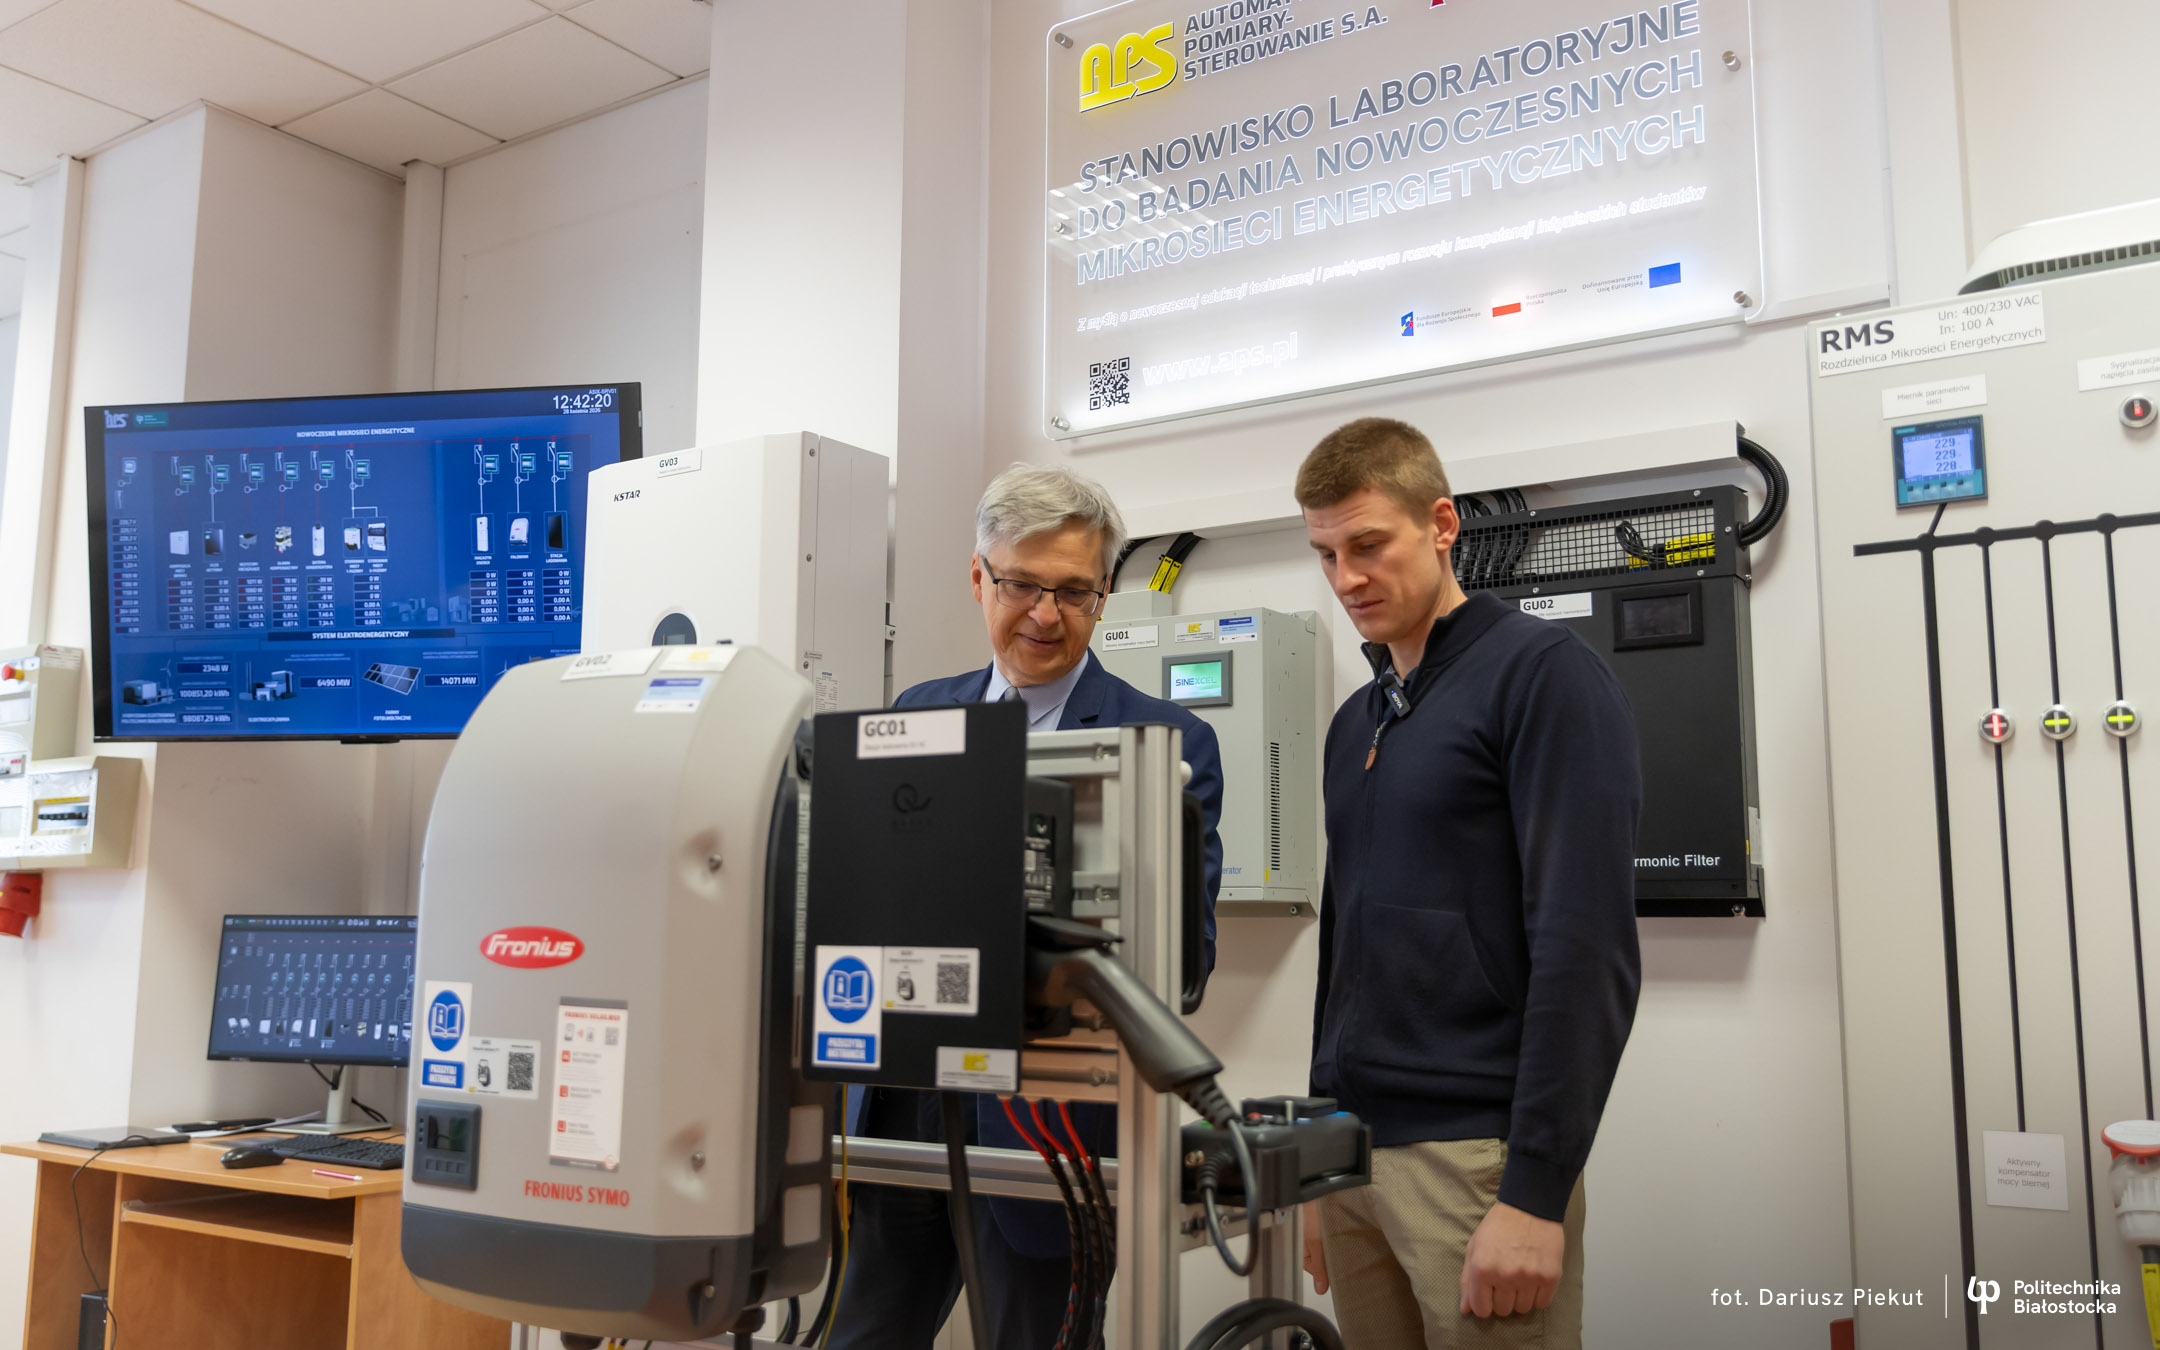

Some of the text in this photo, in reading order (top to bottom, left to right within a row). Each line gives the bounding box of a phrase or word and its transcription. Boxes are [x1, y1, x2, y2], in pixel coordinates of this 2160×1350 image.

[1184, 0, 1302, 36] AUTOMA
[1184, 9, 1294, 59] POMIARY-
[1184, 6, 1388, 82] STEROWANIE S.A.
[1079, 22, 1178, 113] APS
[1080, 0, 1701, 194] STANOWISKO LABORATORYJNE
[1077, 49, 1702, 240] DO BADANIA NOWOCZESNYCH
[1077, 105, 1705, 286] MIKROSIECI ENERGETYCZNYCH
[1076, 318, 1087, 331] Z
[1087, 310, 1119, 332] myślą
[1119, 311, 1128, 323] o
[1129, 293, 1200, 320] nowoczesnej
[1200, 282, 1248, 306] edukacji
[1249, 268, 1315, 295] technicznej
[1322, 252, 1401, 284] praktycznym
[1402, 240, 1453, 264] rozwoju
[1454, 219, 1536, 253] kompetencji
[1629, 184, 1707, 214] studentów
[1582, 275, 1626, 290] Dofinansowane
[1441, 306, 1472, 319] Europejskie
[1938, 294, 2041, 322] Un: 400/230 VAC
[1939, 317, 1994, 335] In: 100 A
[1820, 320, 1894, 353] RMS
[1820, 327, 2043, 372] Rozdzielnica Mikrosieci Energetycznych
[1142, 331, 1298, 386] www.aps.pl
[1897, 384, 1971, 401] Miernik parametrów
[553, 394, 612, 410] 12:42:20
[297, 427, 415, 438] NOWOCZESNE MIKROSIECI ENERGETYCZNE
[1935, 437, 1956, 449] 229
[1935, 449, 1956, 460] 229
[659, 457, 678, 469] GV03
[613, 489, 641, 503] KSTAR
[1523, 599, 1554, 611] GU02
[312, 631, 409, 640] SYSTEM ELEKTROENERGETYCZNY
[1105, 630, 1129, 641] GU01
[575, 654, 612, 668] GV02
[336, 678, 350, 686] MW
[462, 676, 476, 684] MW
[1175, 676, 1217, 687] SINEXCEL
[1392, 692, 1403, 710] BOYA
[864, 719, 907, 738] GC01
[1635, 852, 1720, 868] rmonic Filter
[1221, 865, 1242, 875] erator
[485, 934, 576, 957] Fronius
[2006, 1157, 2041, 1169] Aktywny
[1998, 1168, 2051, 1180] kompensator
[1998, 1178, 2051, 1190] mocy biernej
[524, 1179, 630, 1208] FRONIUS SYMO
